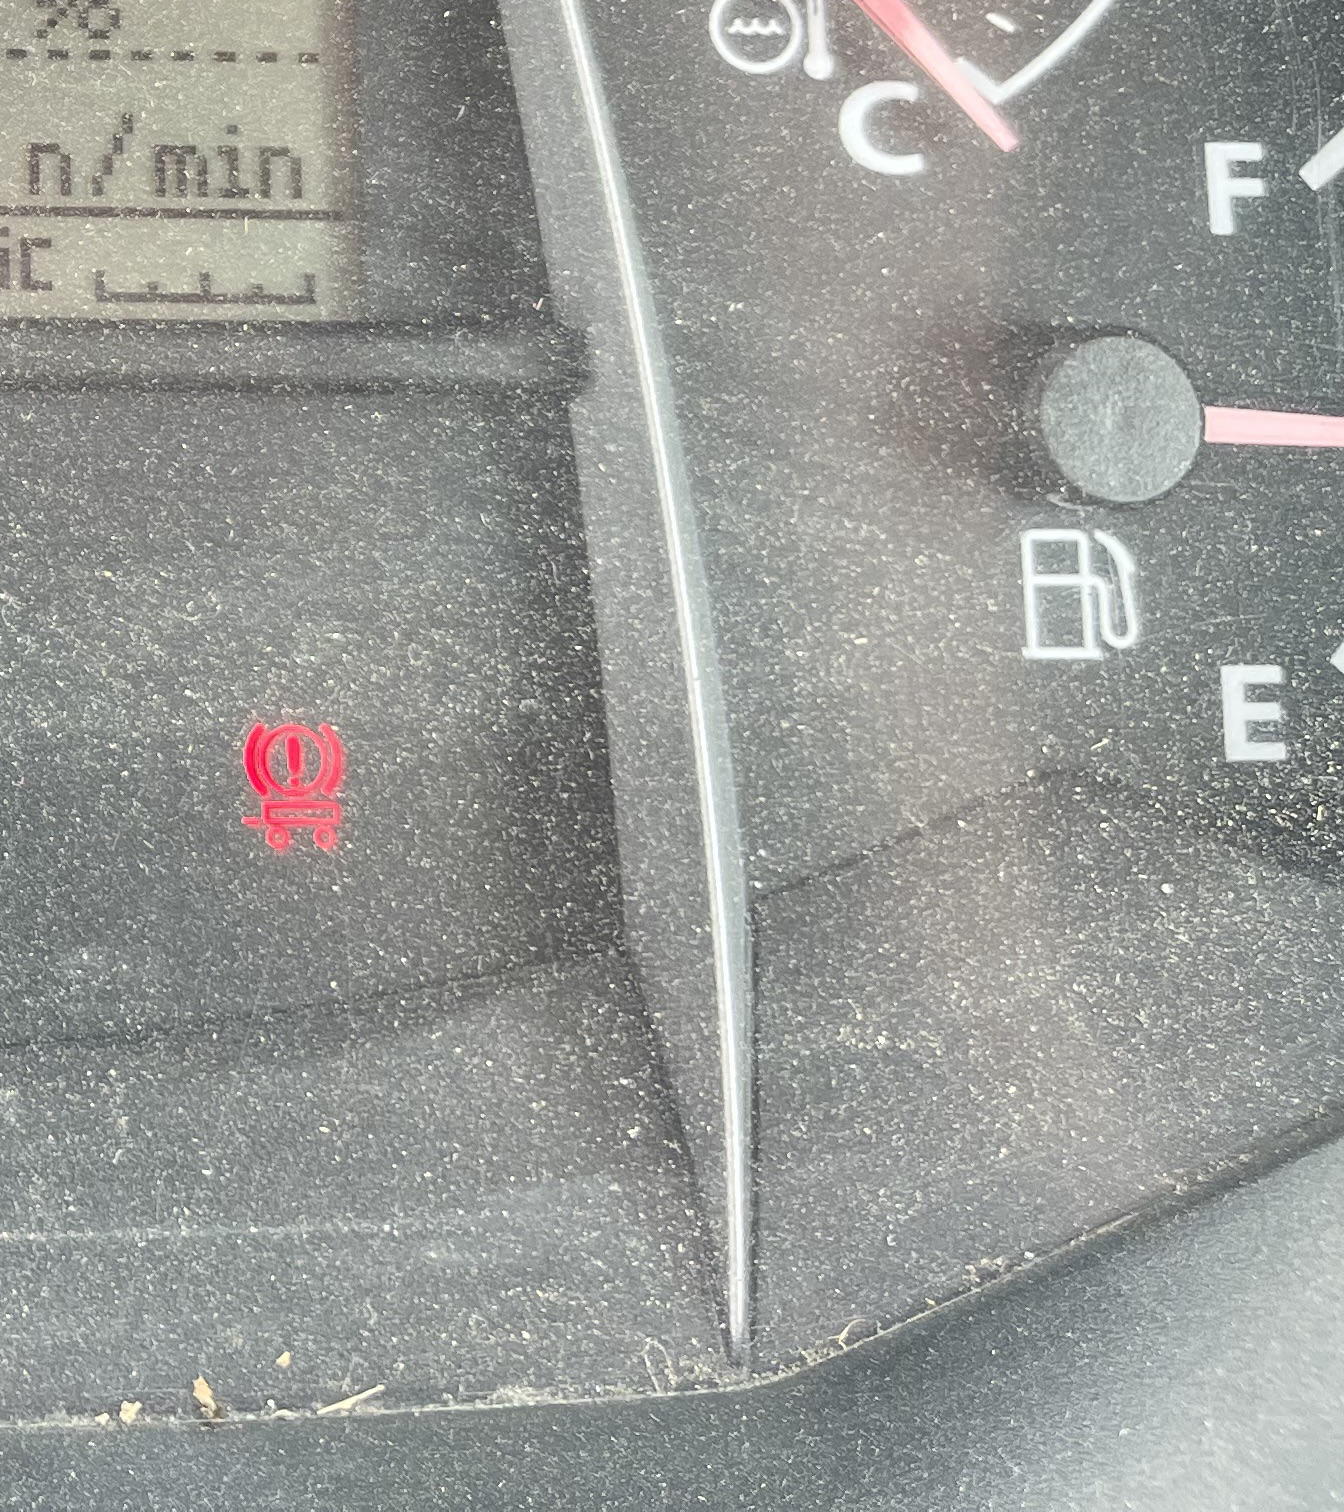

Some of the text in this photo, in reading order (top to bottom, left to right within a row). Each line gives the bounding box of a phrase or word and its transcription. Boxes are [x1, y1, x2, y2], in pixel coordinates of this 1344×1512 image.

[25, 113, 304, 199] n/min
[838, 82, 924, 175] C
[1205, 141, 1265, 235] F
[1220, 664, 1287, 761] E
